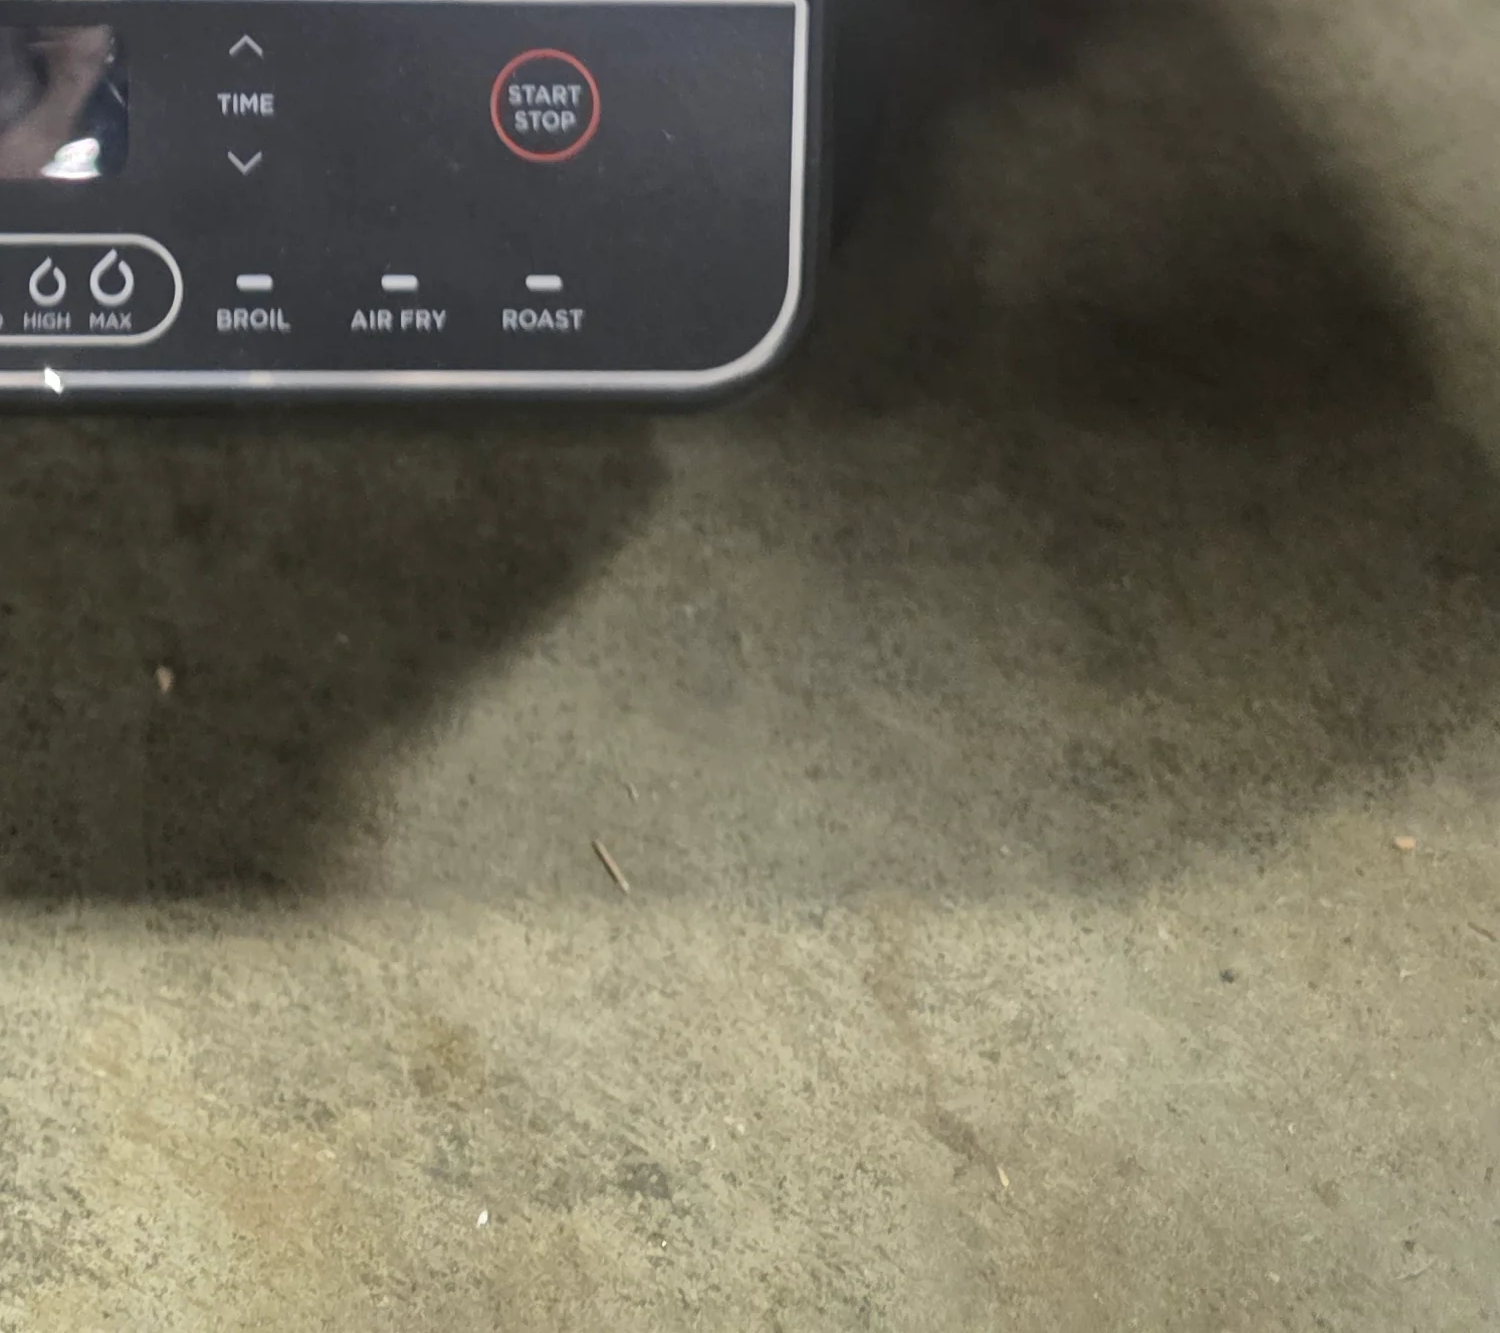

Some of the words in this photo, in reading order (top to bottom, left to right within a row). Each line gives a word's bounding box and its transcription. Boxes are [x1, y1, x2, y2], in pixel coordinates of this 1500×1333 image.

[217, 92, 275, 116] TIME
[507, 84, 582, 108] START
[513, 110, 577, 133] STOP
[23, 312, 72, 330] HIGH
[89, 312, 132, 331] MAX
[216, 309, 290, 332] BROIL
[350, 309, 393, 332] AIR
[400, 309, 447, 332] FRY
[501, 309, 583, 332] ROAST
